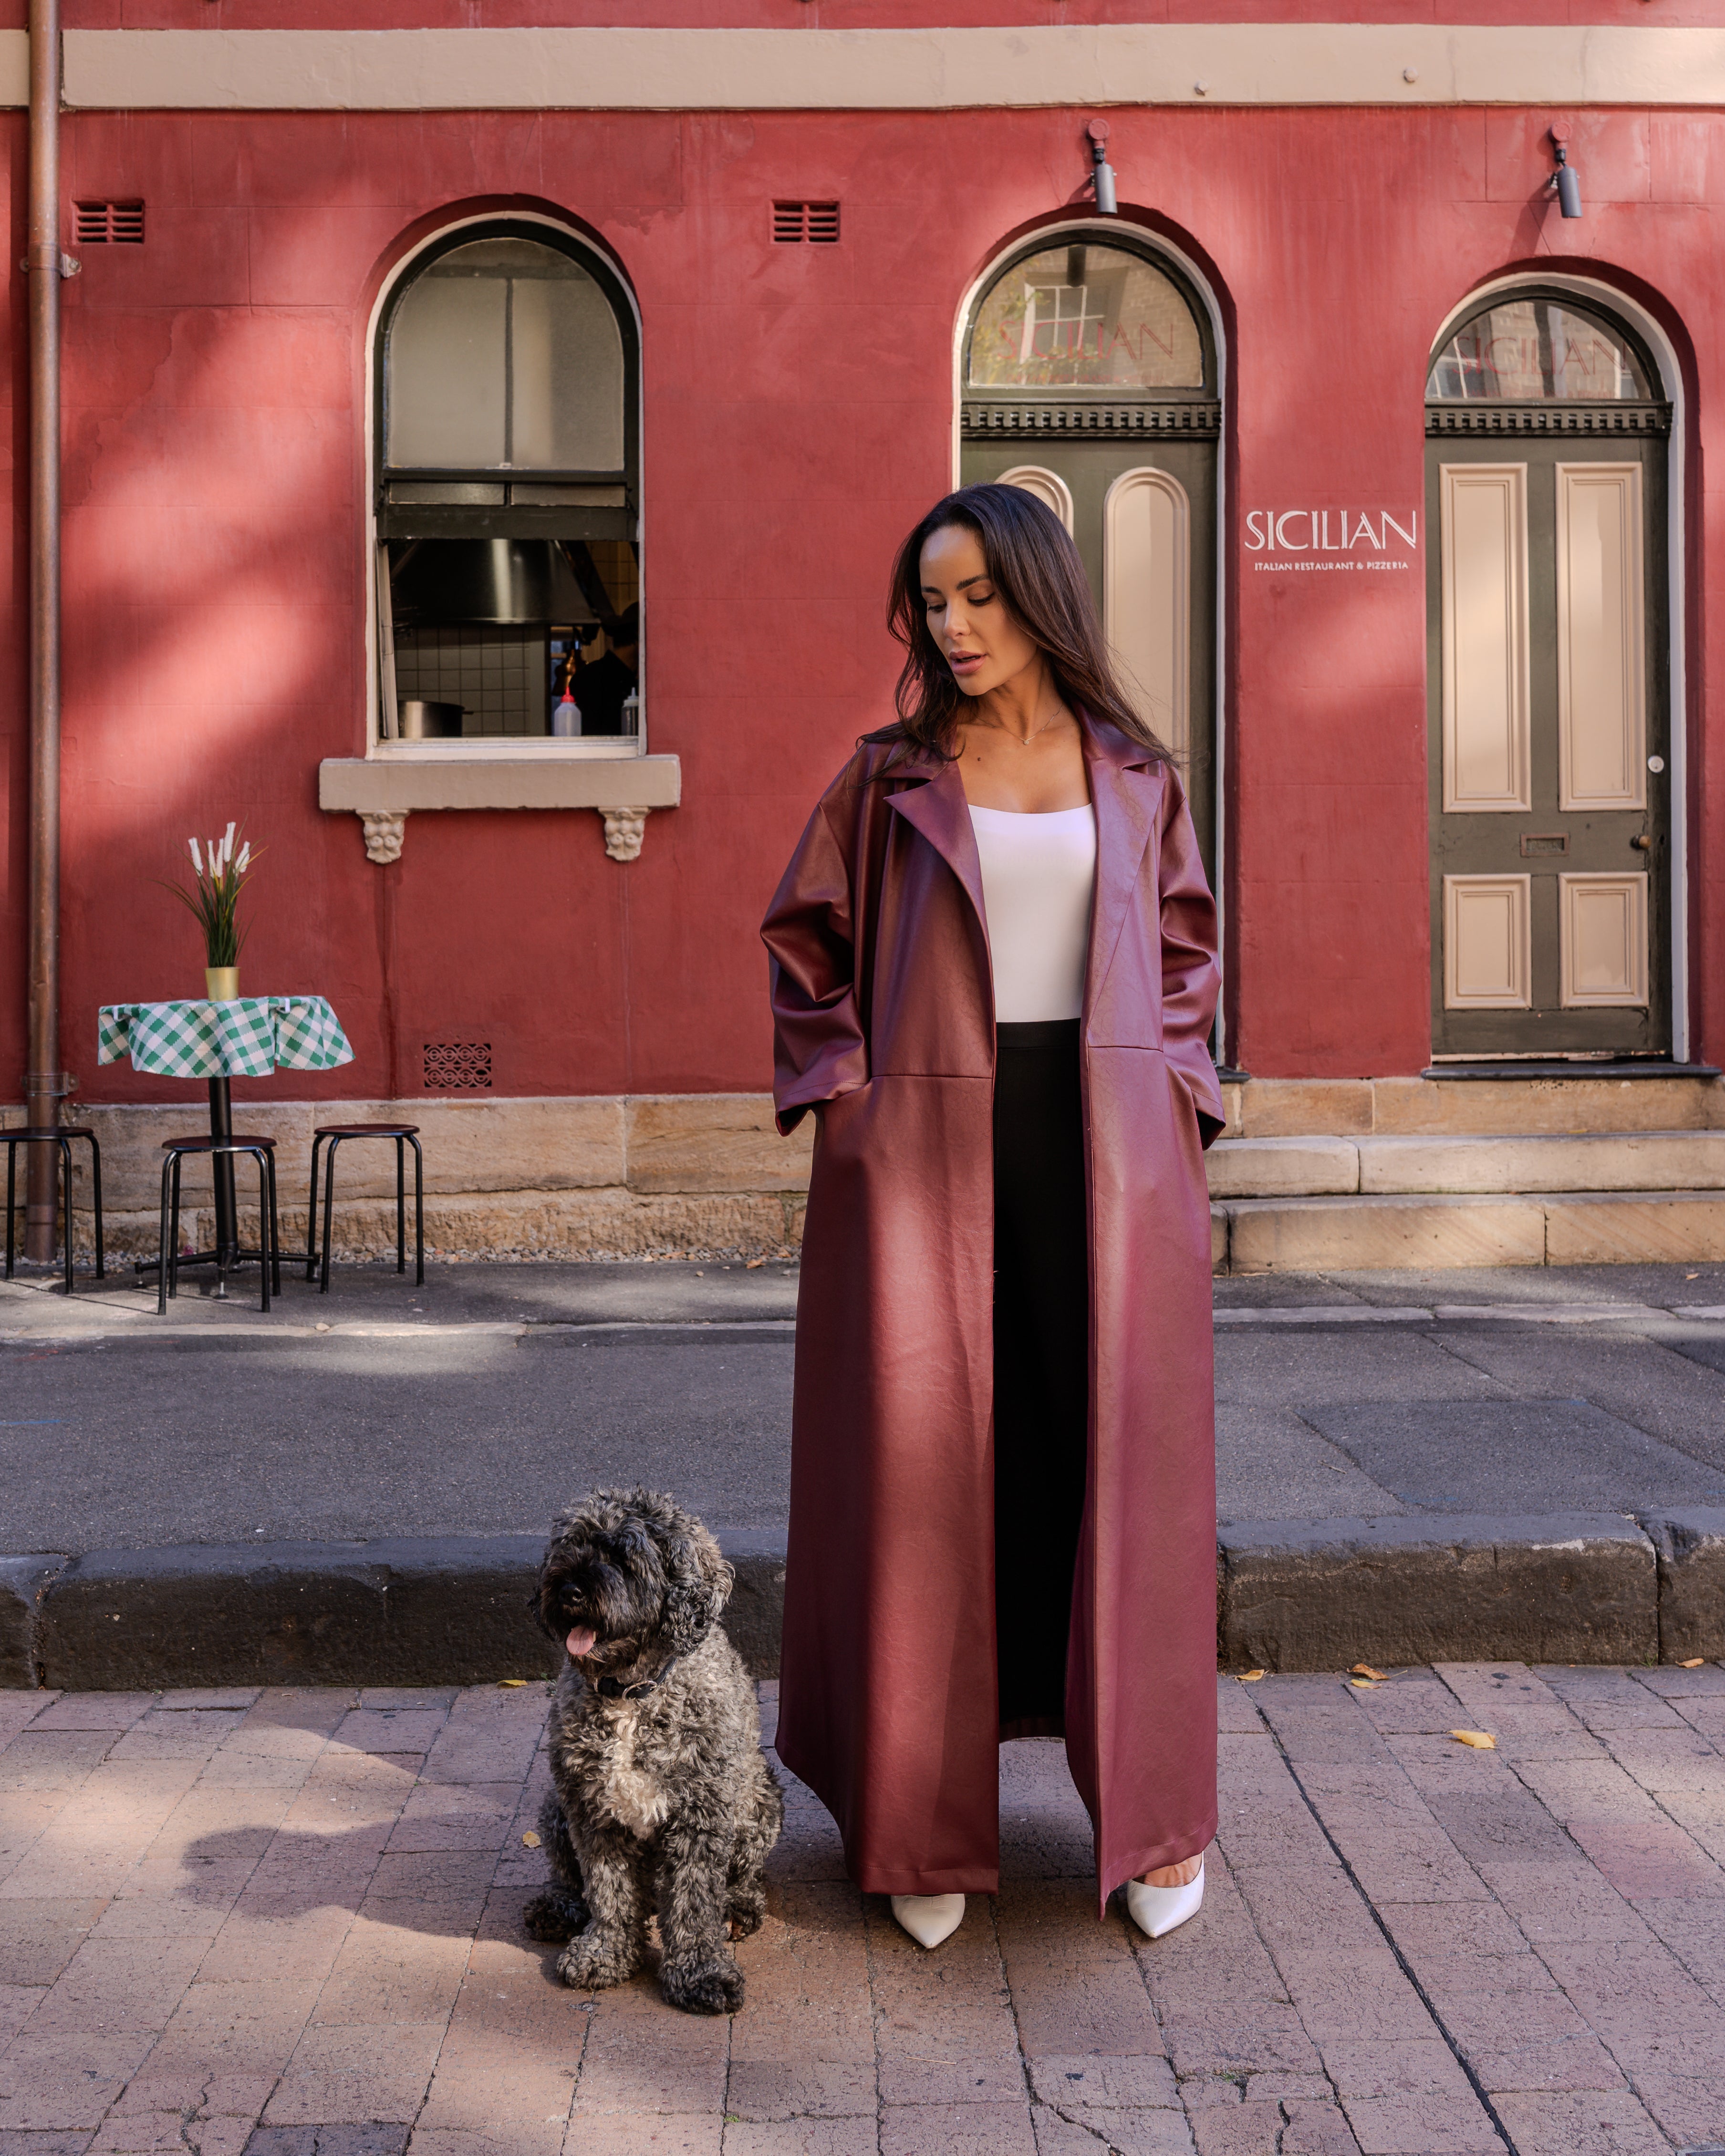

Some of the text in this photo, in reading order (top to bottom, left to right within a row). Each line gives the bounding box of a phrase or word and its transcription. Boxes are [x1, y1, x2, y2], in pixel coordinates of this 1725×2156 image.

[997, 320, 1174, 360] SICILIAN
[1452, 336, 1627, 376] SICILIAN
[1244, 510, 1416, 550] SICILIAN
[1255, 561, 1409, 571] ITALIAN RESTAURANT & PIZZERIA
